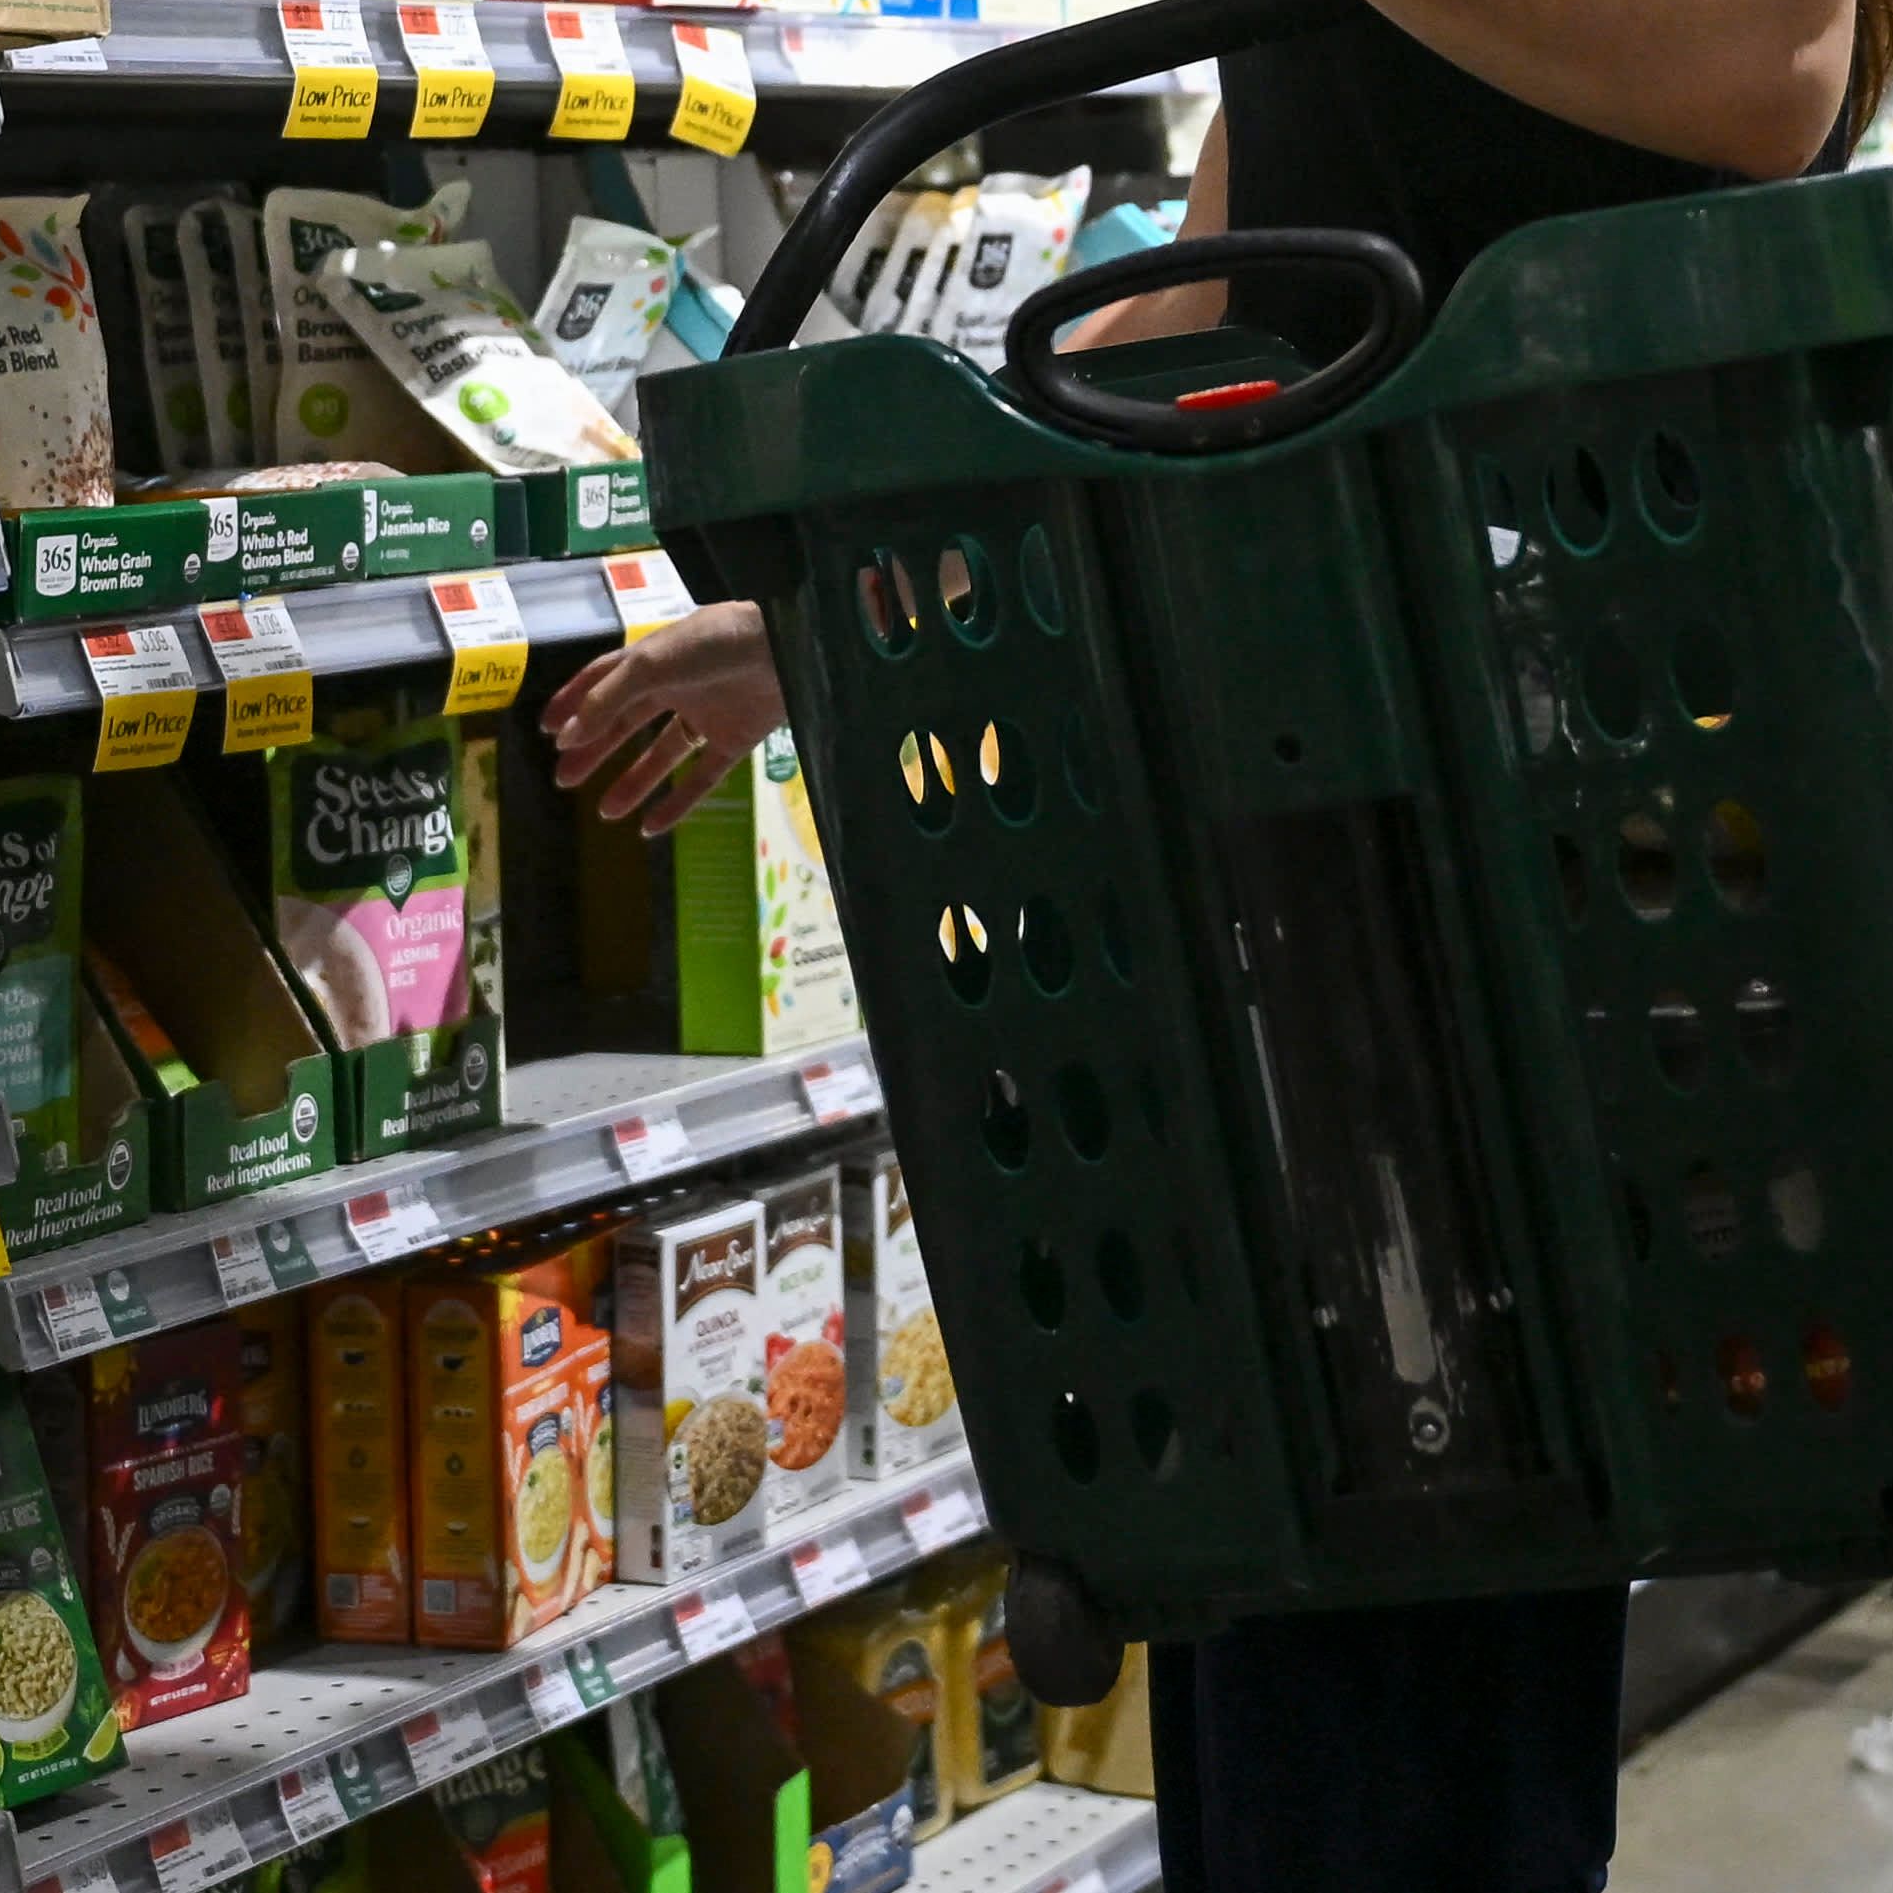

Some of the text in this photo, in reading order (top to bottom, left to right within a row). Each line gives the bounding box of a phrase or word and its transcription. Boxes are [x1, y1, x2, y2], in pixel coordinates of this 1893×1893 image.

[298, 83, 371, 109] Low Price
[423, 84, 487, 111] Low Price
[565, 92, 629, 115] Low Price
[9, 325, 43, 348] Red
[10, 350, 60, 374] Blend
[241, 534, 275, 553] White
[286, 528, 309, 547] Red
[379, 517, 451, 539] Jasmine Rice
[41, 532, 118, 573] 365 Organic
[80, 552, 152, 575] Whole Grain
[241, 546, 315, 571] Quinoa Blend
[79, 572, 144, 594] Brown Rice
[232, 691, 307, 722] Low Price
[314, 764, 434, 818] Seeds
[386, 903, 462, 941] Organic
[388, 944, 441, 966] JASMINE
[388, 969, 417, 989] RICE
[230, 1131, 288, 1163] Real food
[207, 1152, 311, 1194] Real ingredients
[35, 1181, 102, 1220] Real food
[133, 1459, 185, 1492] SPANISH
